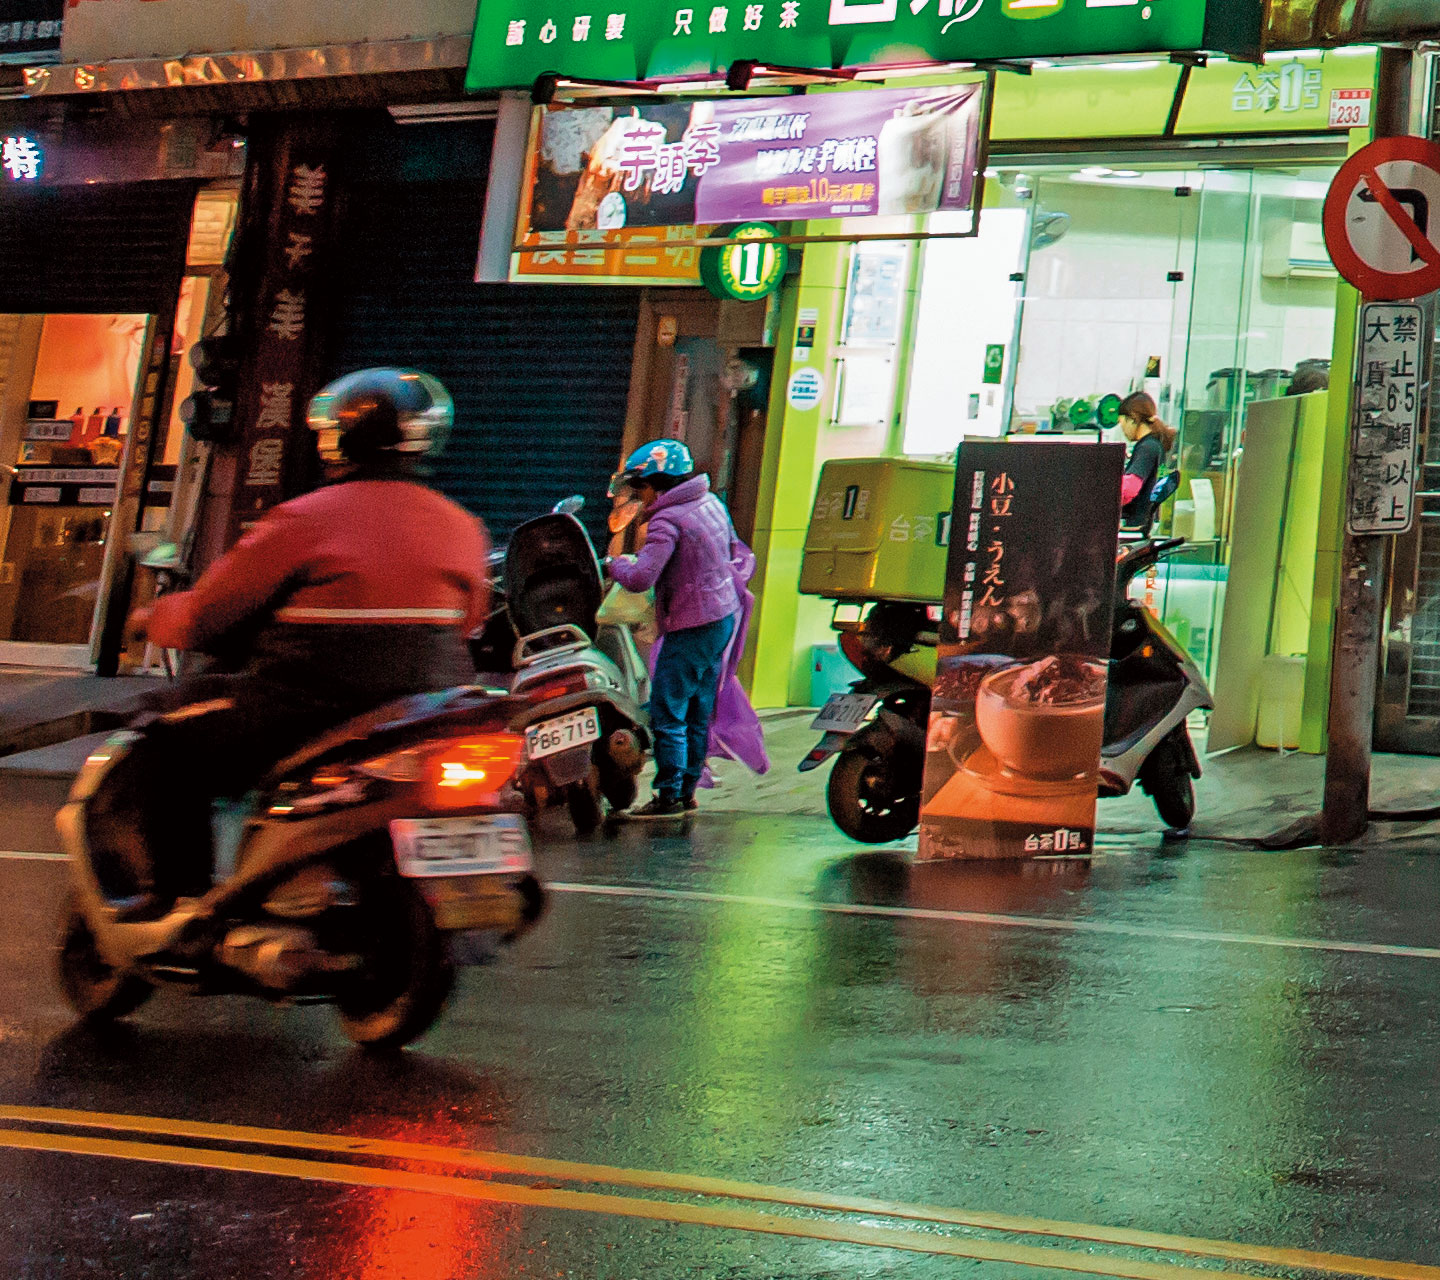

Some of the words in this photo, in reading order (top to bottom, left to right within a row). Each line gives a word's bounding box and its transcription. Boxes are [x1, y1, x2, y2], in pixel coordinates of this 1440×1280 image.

[1336, 105, 1362, 124] 233
[3, 137, 40, 180] 特
[618, 121, 723, 194] 芋頭季
